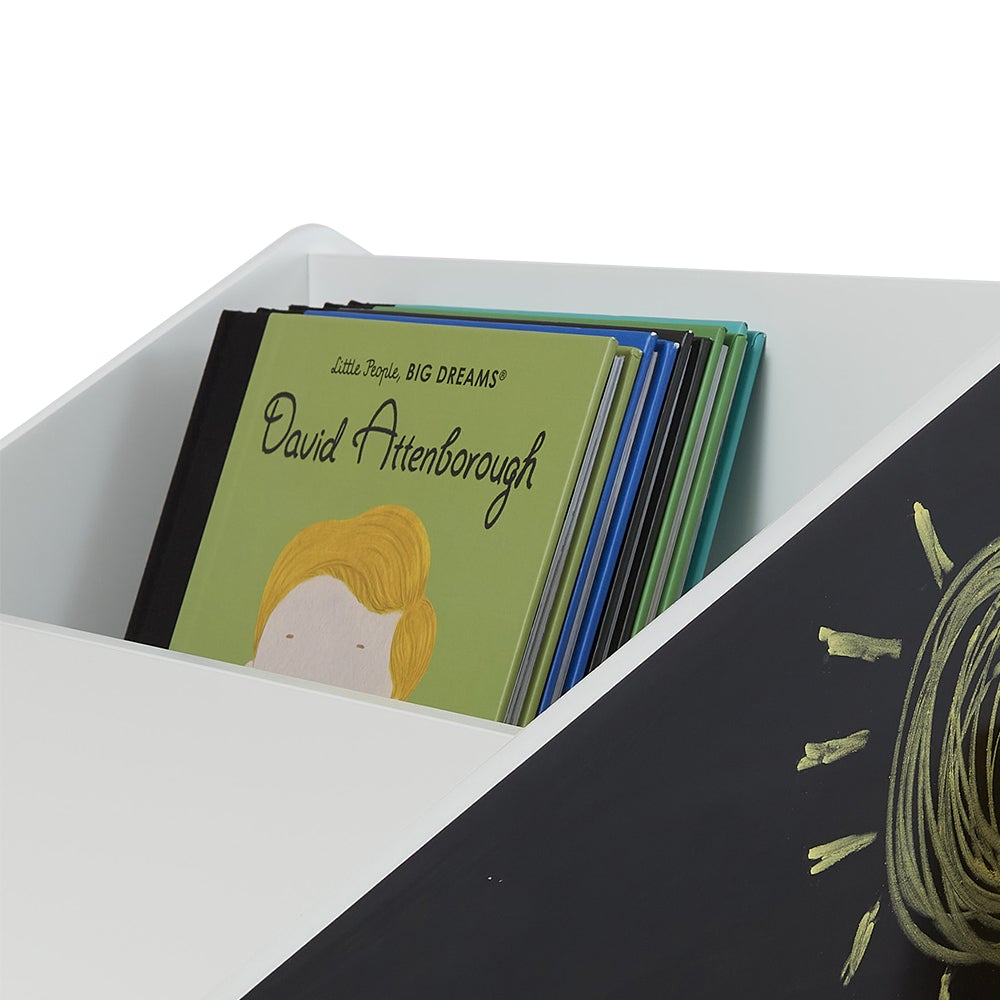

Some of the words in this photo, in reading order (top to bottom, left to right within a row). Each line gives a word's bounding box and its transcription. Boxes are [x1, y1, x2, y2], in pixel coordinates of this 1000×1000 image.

[330, 356, 361, 376] Little
[363, 358, 400, 386] People,
[406, 363, 432, 382] BIG
[262, 391, 348, 463] David
[352, 398, 546, 529] Attenborough
